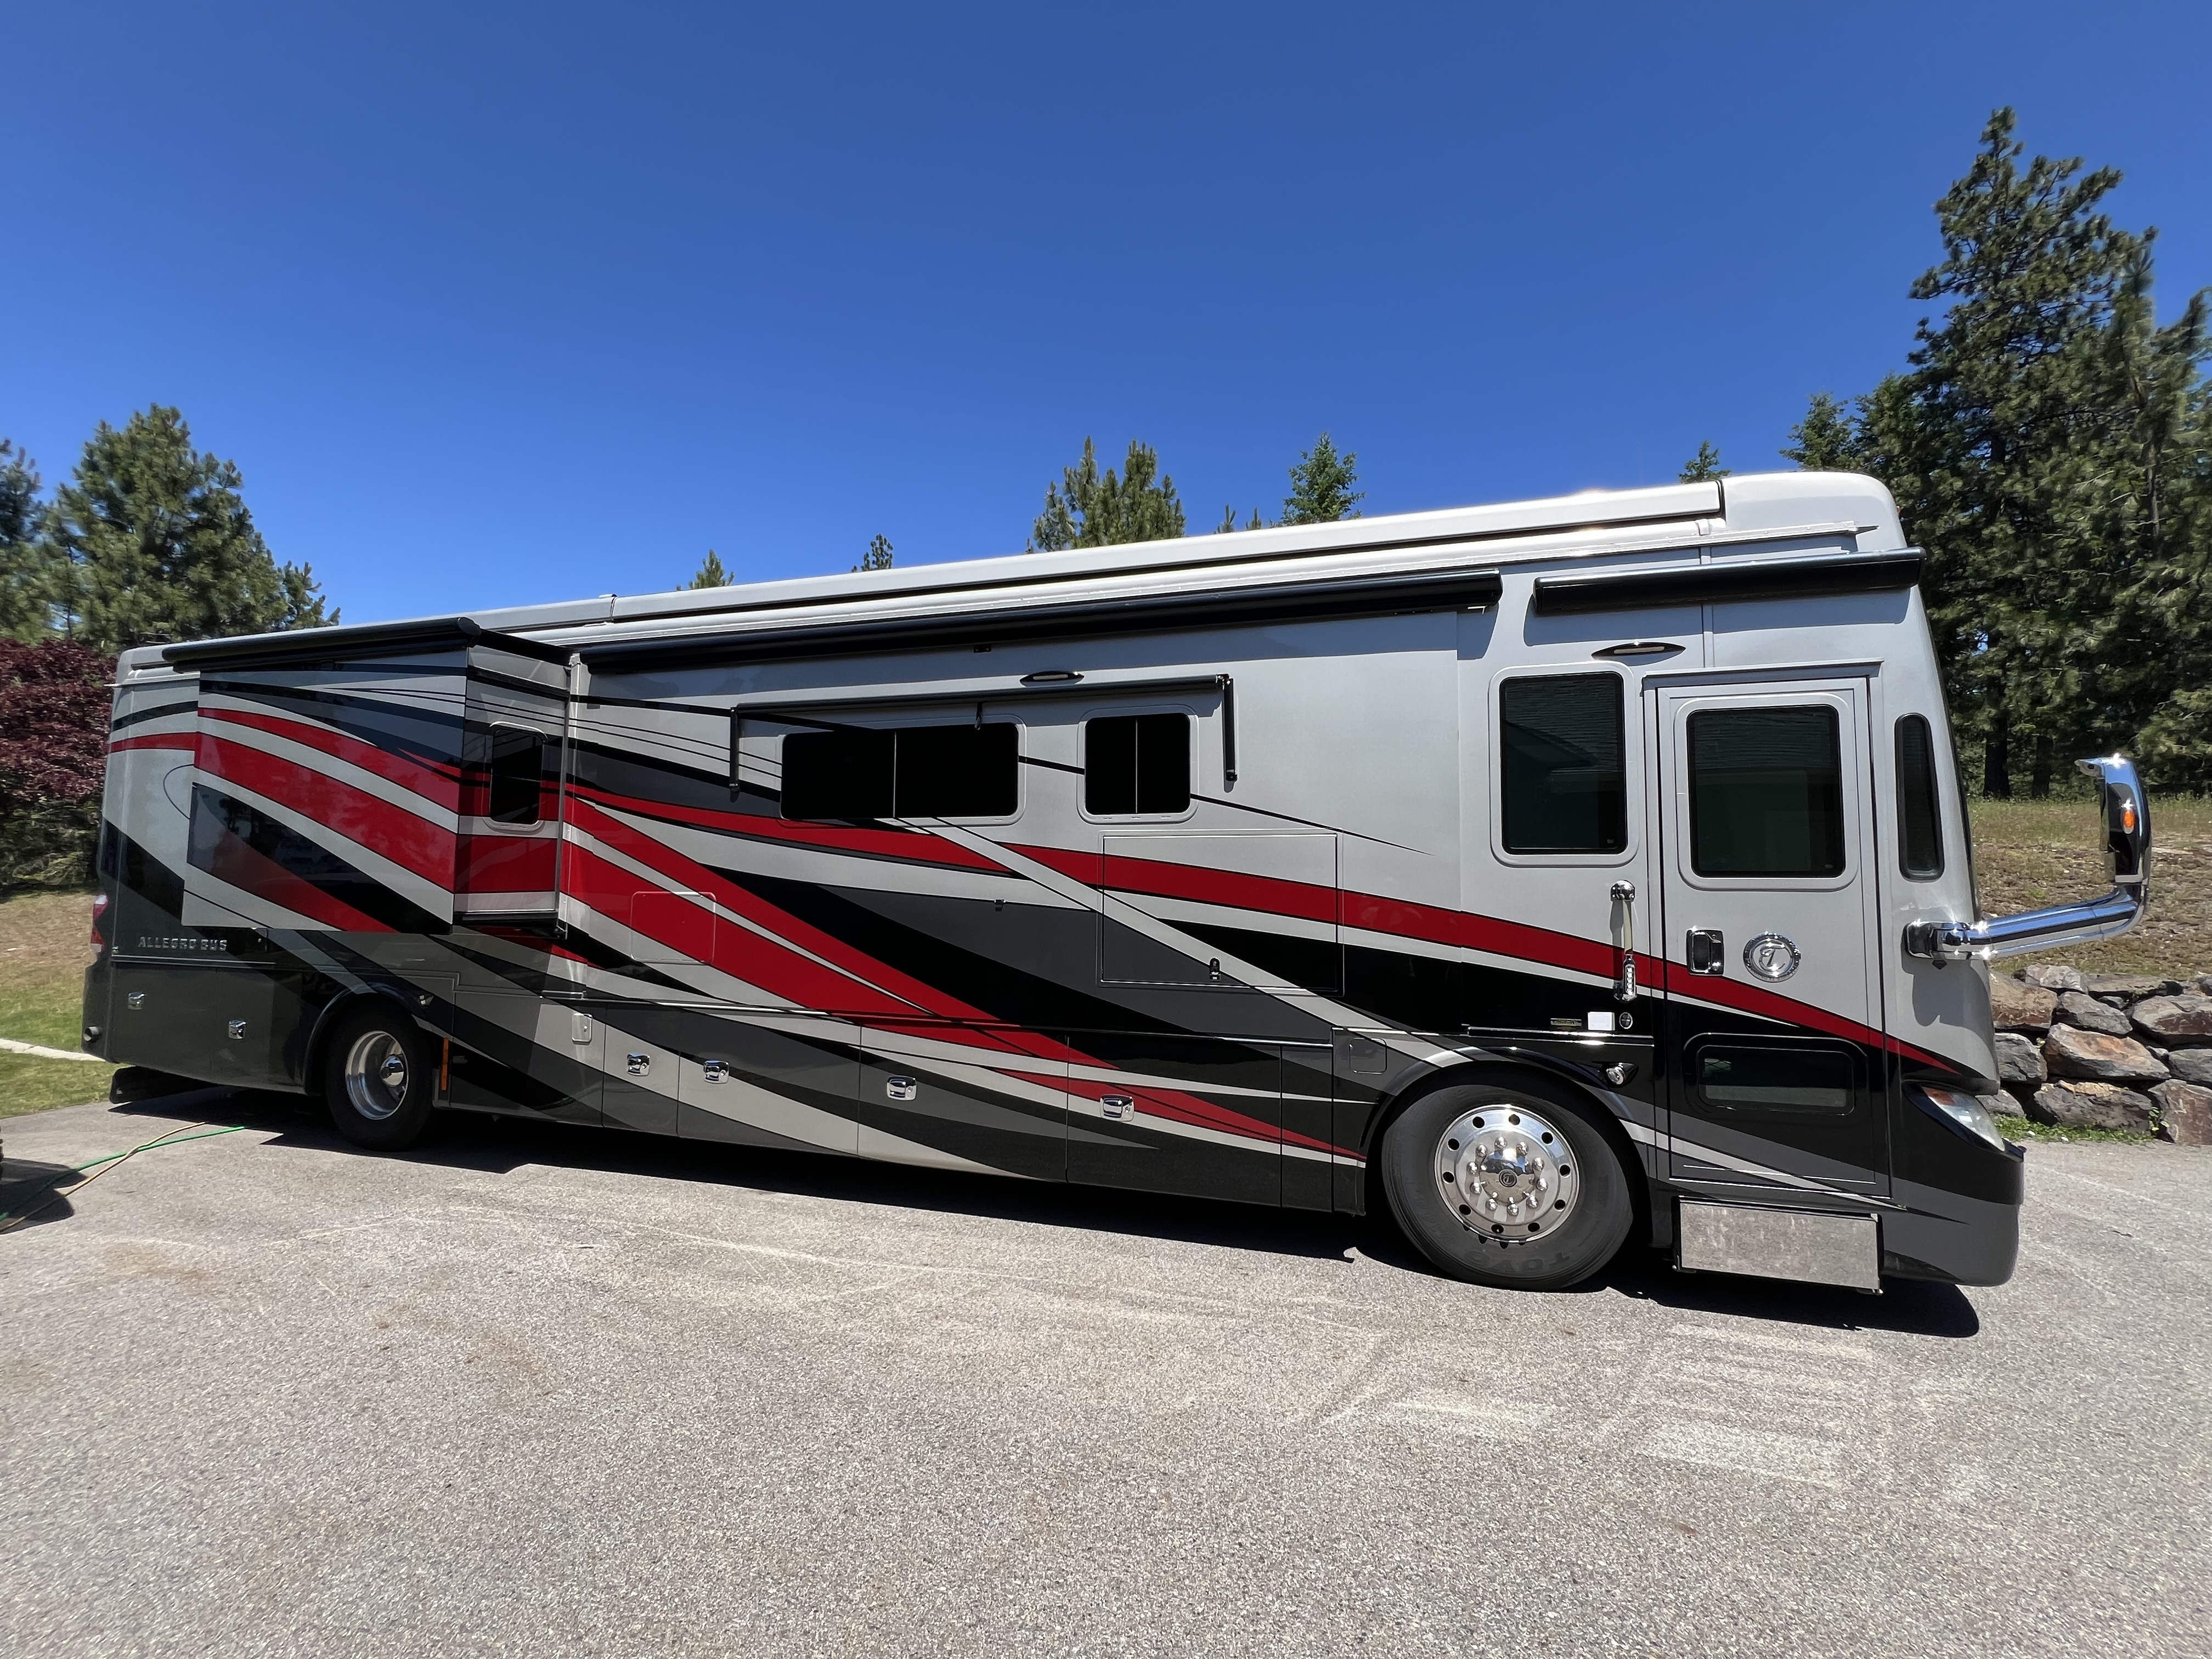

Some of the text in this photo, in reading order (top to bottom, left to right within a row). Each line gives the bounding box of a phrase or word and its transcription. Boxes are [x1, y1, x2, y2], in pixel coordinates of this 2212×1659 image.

[138, 936, 228, 951] ALLEGRO BUS
[1464, 1250, 1571, 1274] TOYO
